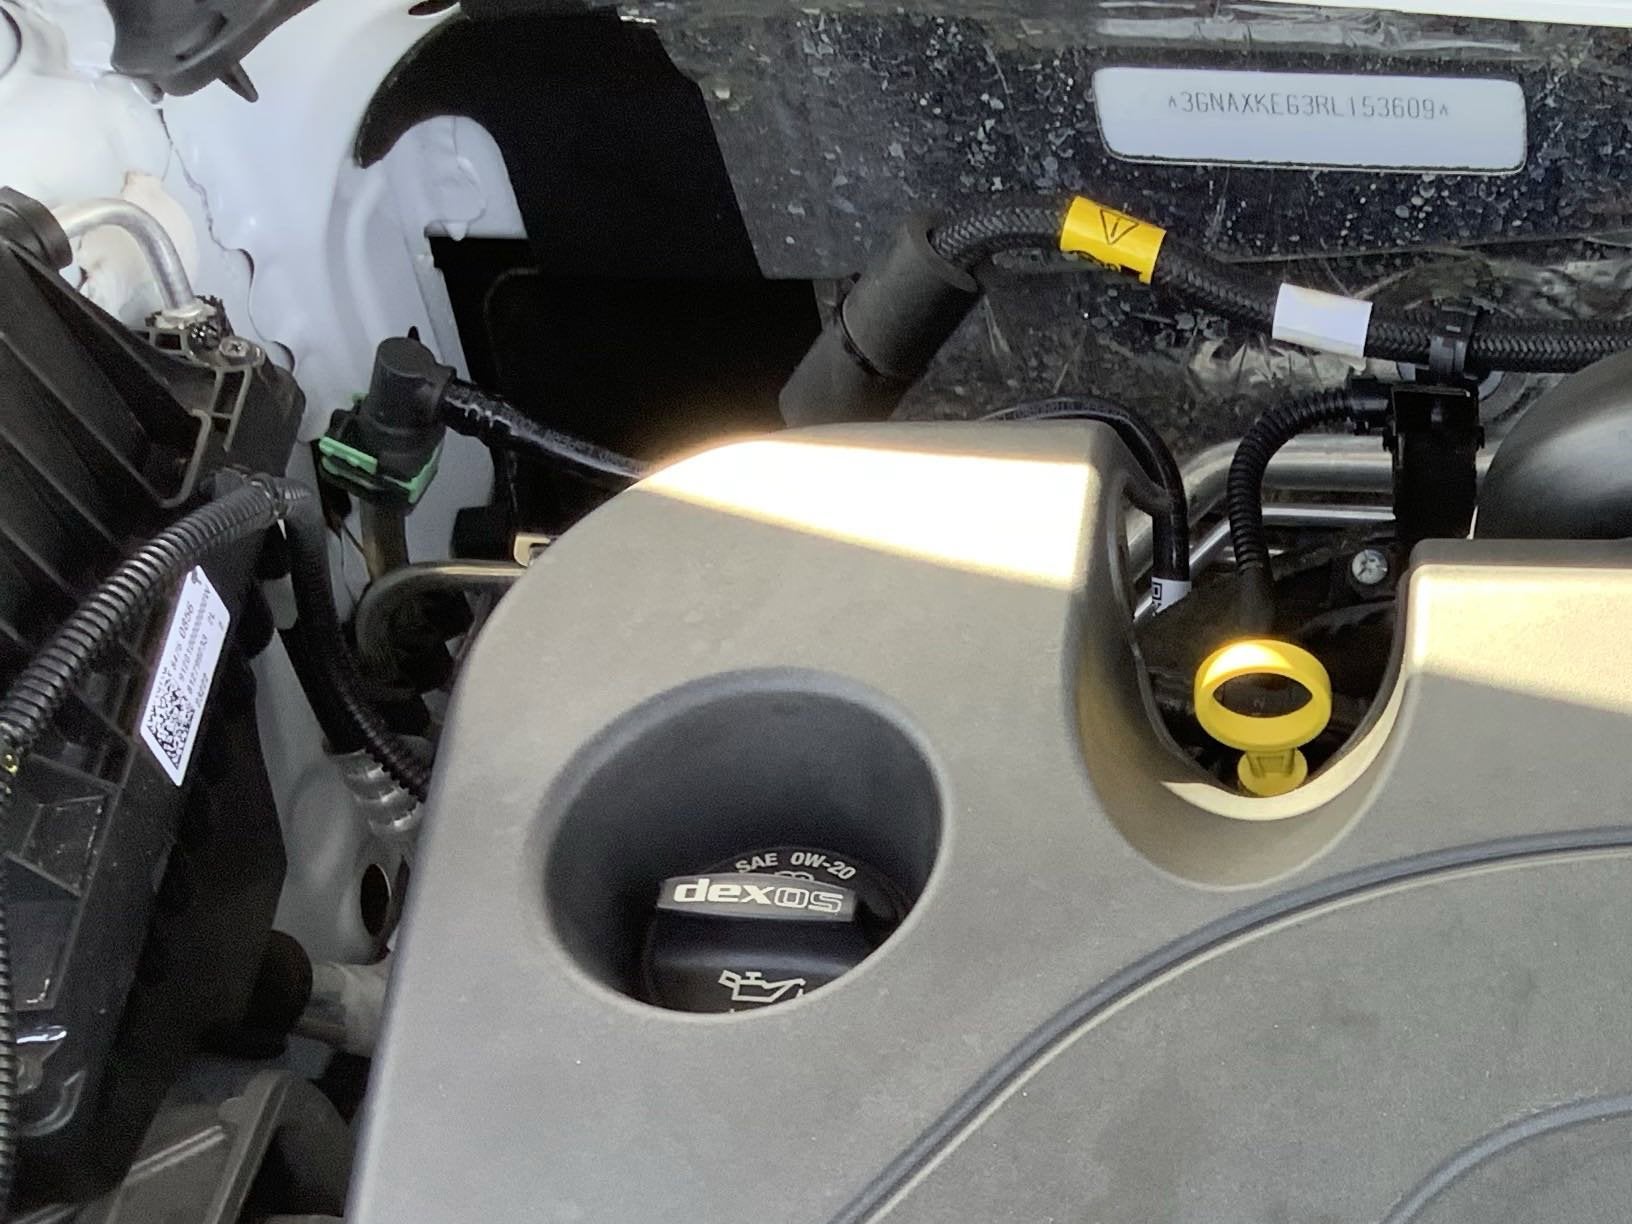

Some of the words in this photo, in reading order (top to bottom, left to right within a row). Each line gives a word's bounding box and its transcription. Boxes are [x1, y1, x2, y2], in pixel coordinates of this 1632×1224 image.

[736, 852, 778, 873] SAE
[790, 851, 857, 881] 0W-20
[673, 878, 844, 914] dexos
